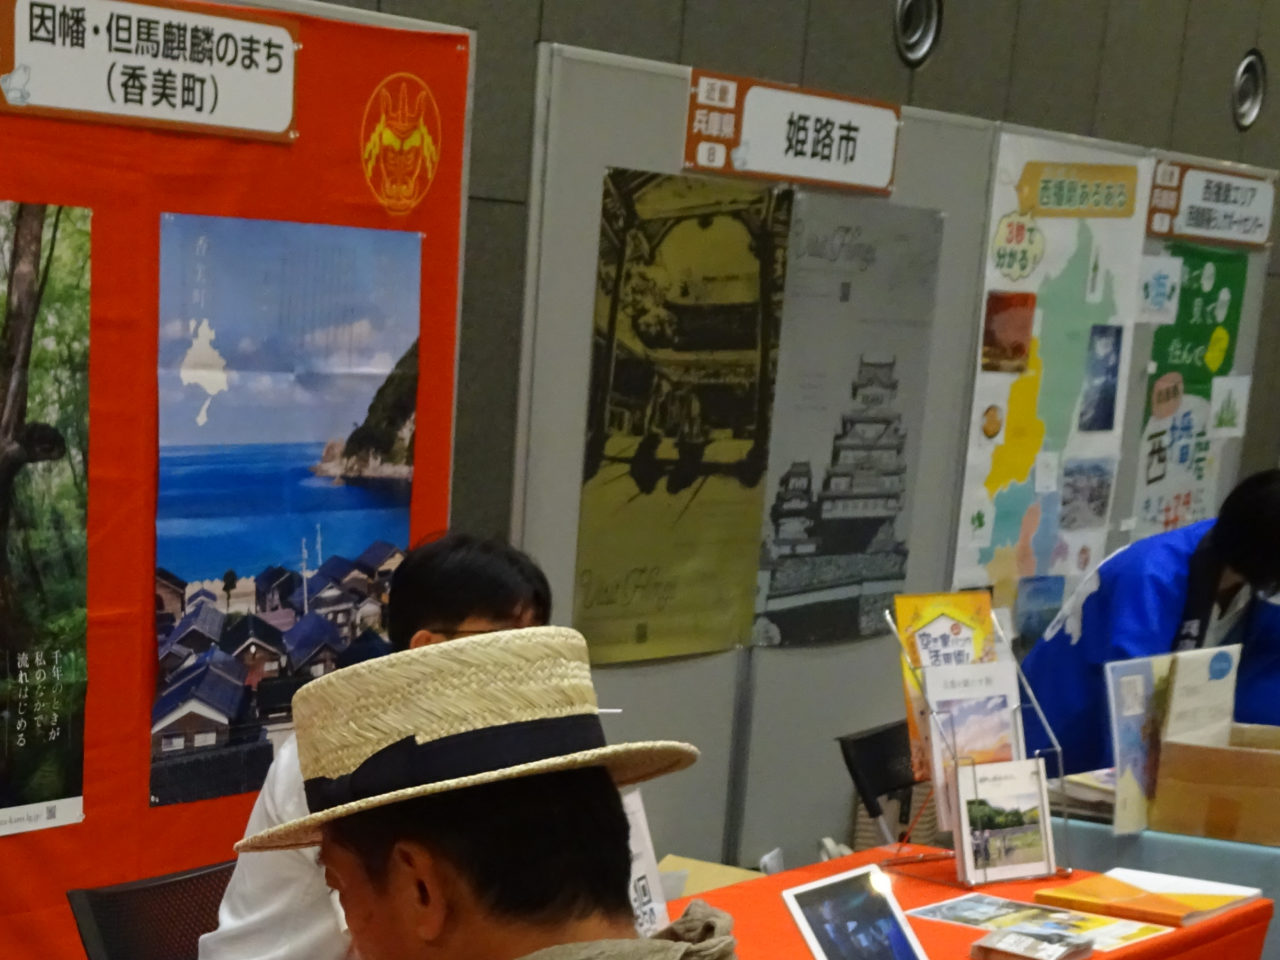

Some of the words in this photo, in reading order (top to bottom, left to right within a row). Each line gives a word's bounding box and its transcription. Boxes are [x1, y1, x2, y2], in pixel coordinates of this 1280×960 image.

[28, 1, 284, 74] 因幡・但馬麒麟のまち
[784, 111, 860, 164] 姫路市
[16, 652, 30, 747] 流れはじめる
[33, 650, 47, 728] 私のなかで
[49, 648, 64, 742] 千年のときが
